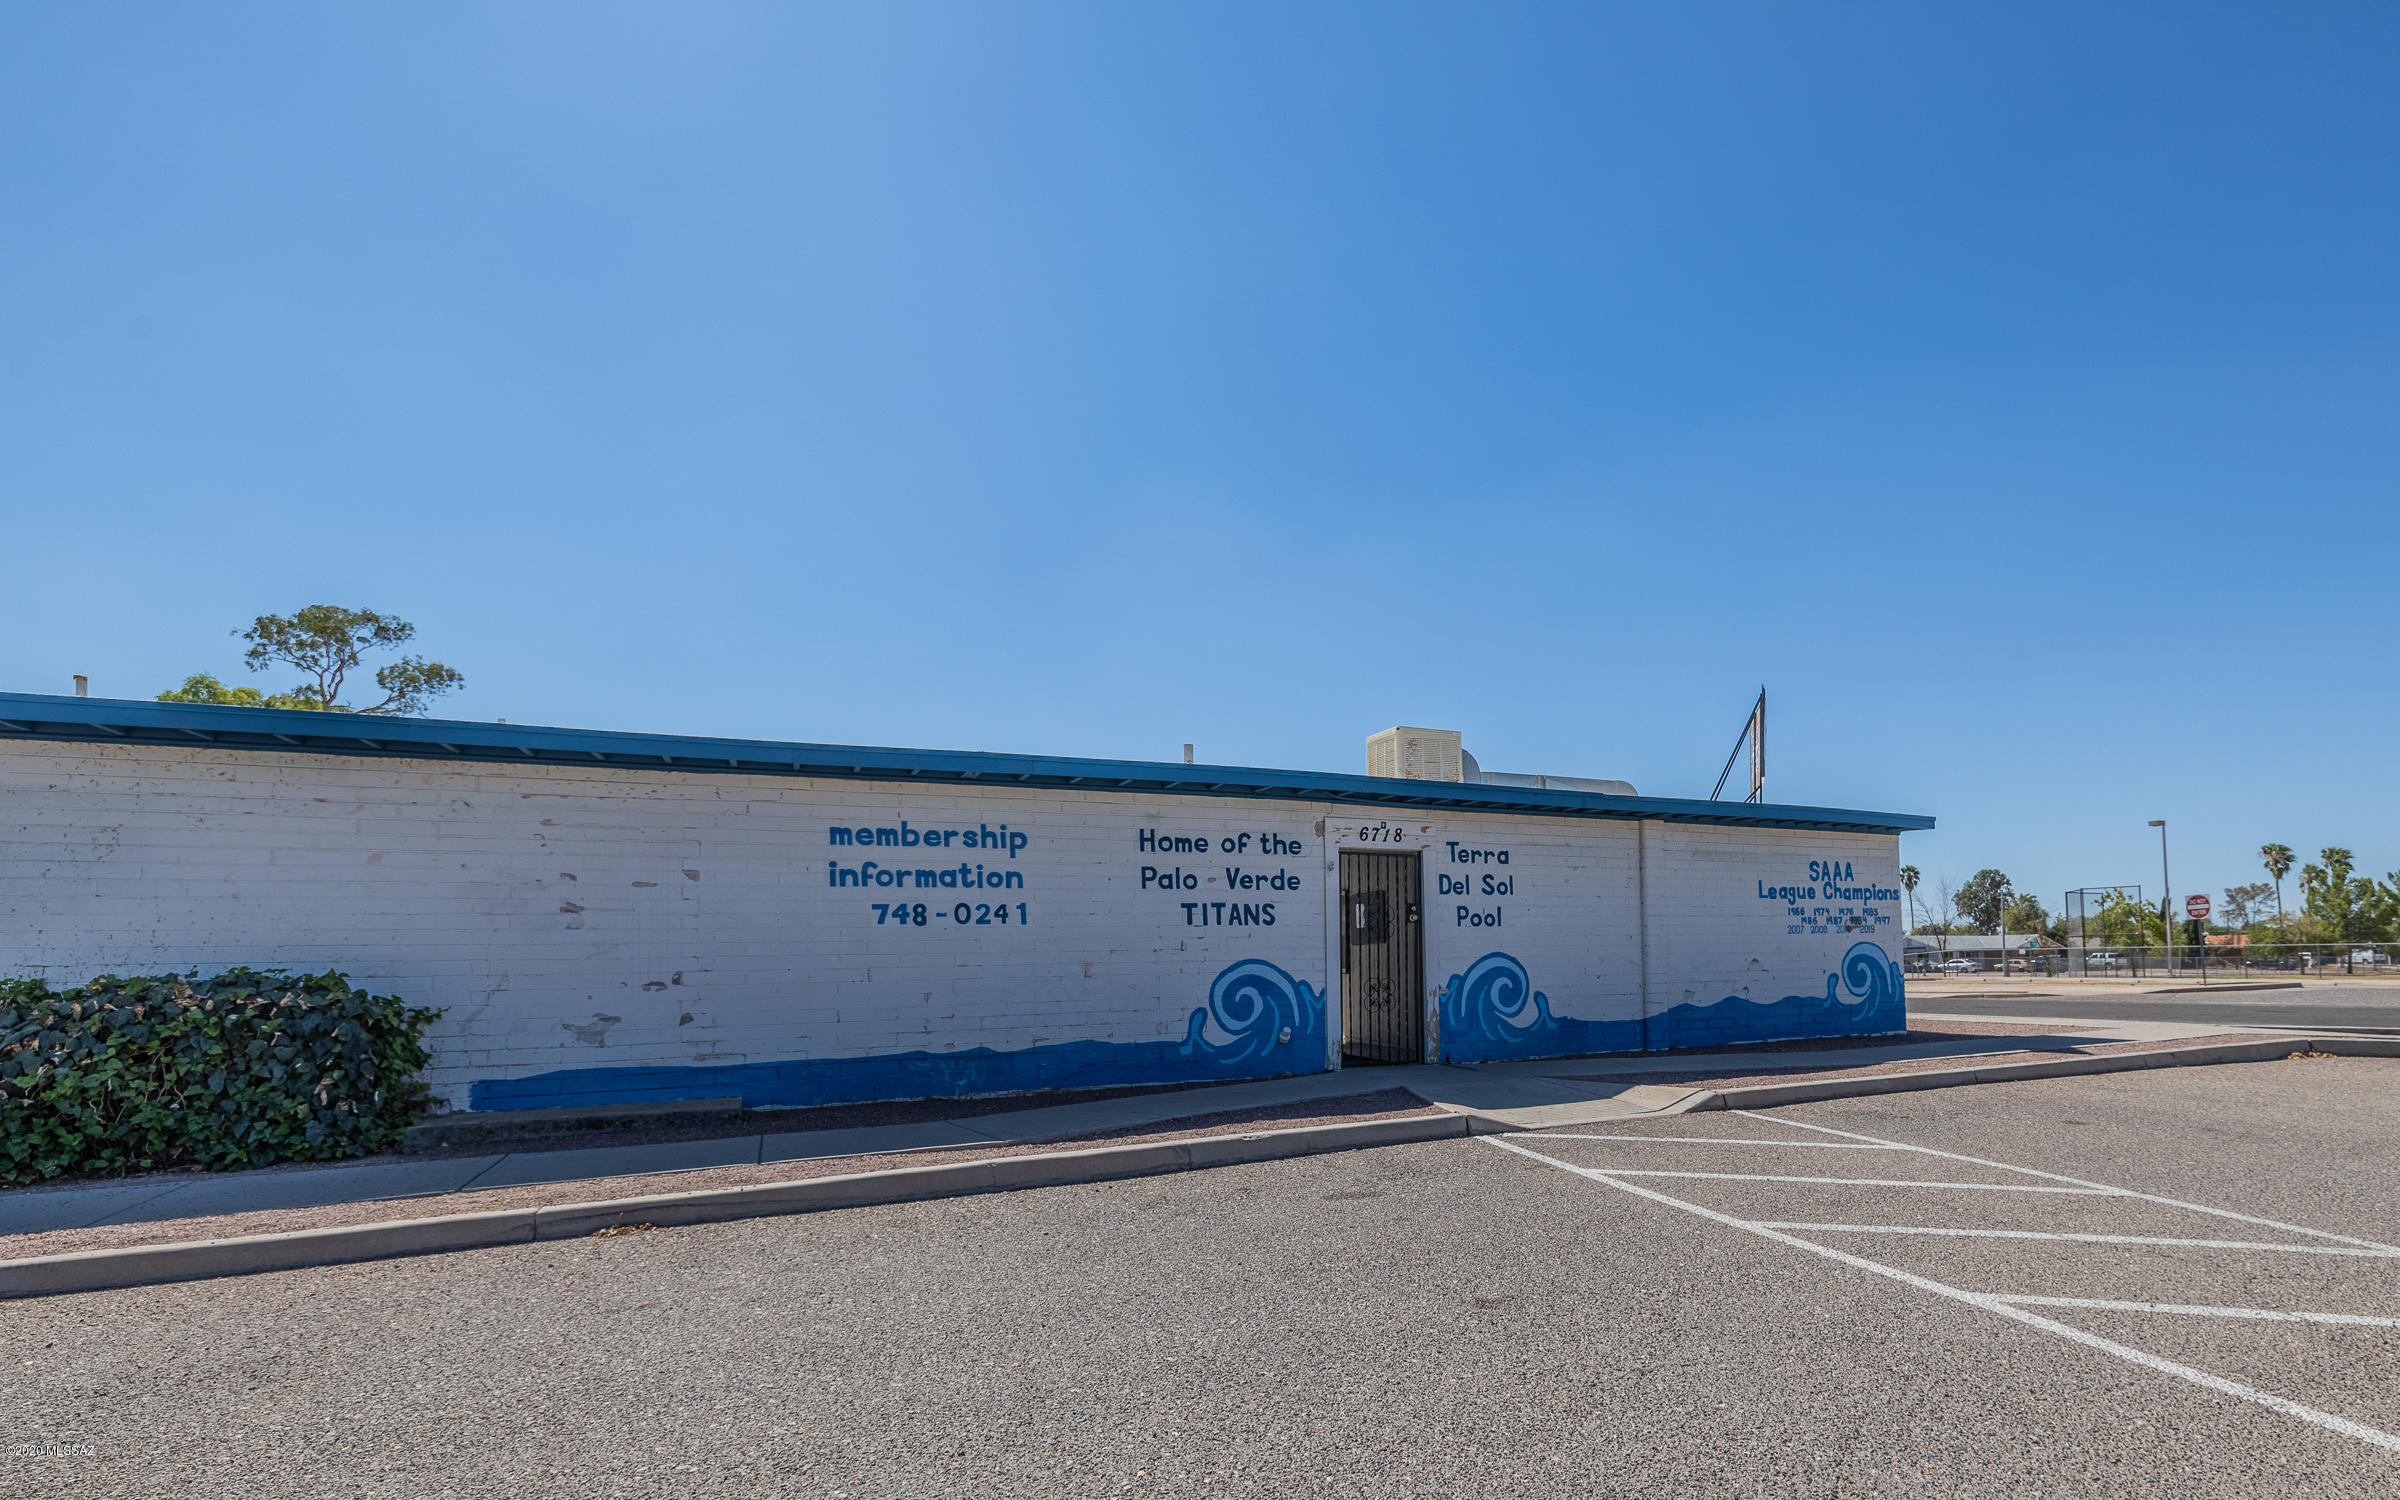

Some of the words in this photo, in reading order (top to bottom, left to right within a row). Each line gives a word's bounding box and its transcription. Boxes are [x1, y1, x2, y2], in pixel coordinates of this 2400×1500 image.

[829, 821, 1028, 858] membership
[1139, 828, 1209, 853] Home
[1221, 832, 1251, 853] of
[1260, 833, 1302, 855] the
[1359, 826, 1403, 843] 6718
[1446, 841, 1509, 864] Terra
[828, 861, 1024, 889] information
[1140, 866, 1198, 889] Palo
[1225, 867, 1301, 890] Verde
[1808, 860, 1854, 882] SAAA
[1438, 873, 1470, 895] Del
[1481, 873, 1513, 895] Sol
[1758, 880, 1816, 905] League
[1823, 881, 1900, 906] Champions
[871, 902, 1028, 927] 748-0241
[1180, 902, 1276, 926] TITANS
[1457, 905, 1502, 927] Pool
[1813, 907, 1830, 916] 1974
[1874, 916, 1890, 925] 1997
[1787, 925, 1804, 934] 2007
[1836, 925, 1851, 934] 201
